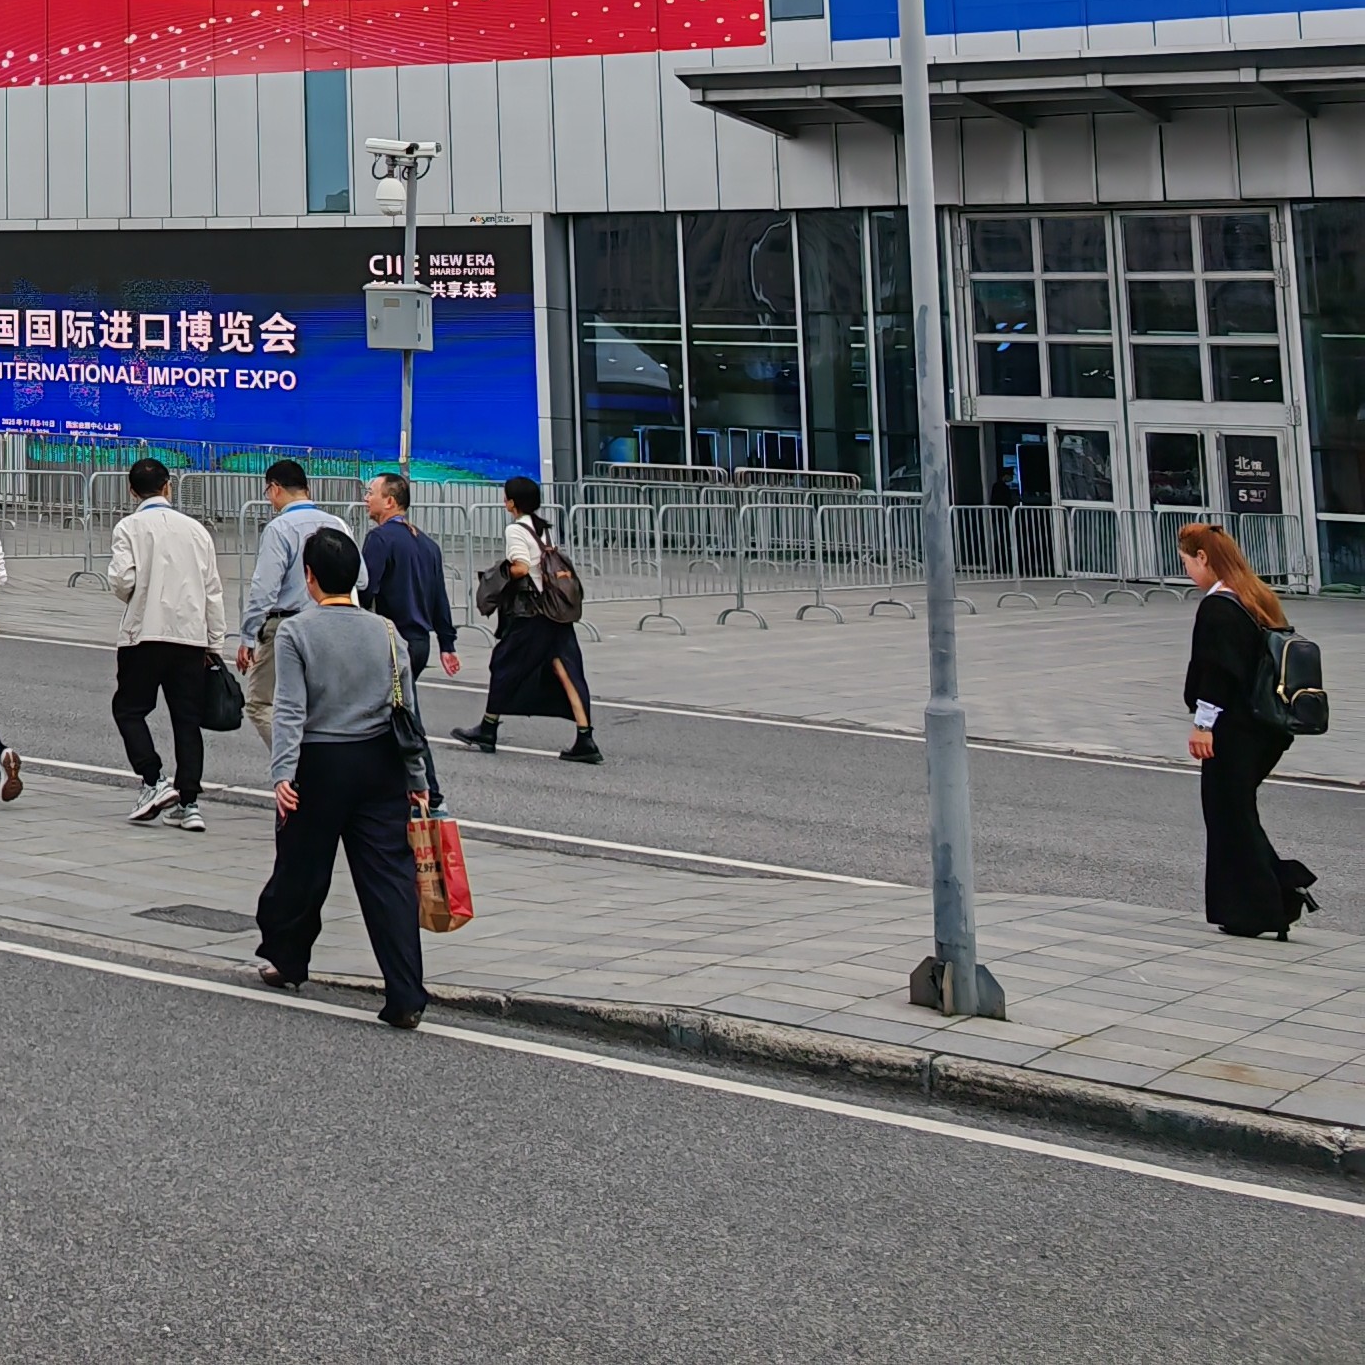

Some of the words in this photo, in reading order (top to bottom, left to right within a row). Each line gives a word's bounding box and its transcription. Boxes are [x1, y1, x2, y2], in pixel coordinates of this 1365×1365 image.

[429, 254, 463, 267] NEW
[466, 254, 495, 267] ERA
[429, 268, 462, 276] SHARED
[463, 268, 495, 276] FUTURE
[430, 280, 497, 299] 共享未来
[147, 366, 229, 388] IMPORT
[235, 370, 297, 391] EXPO
